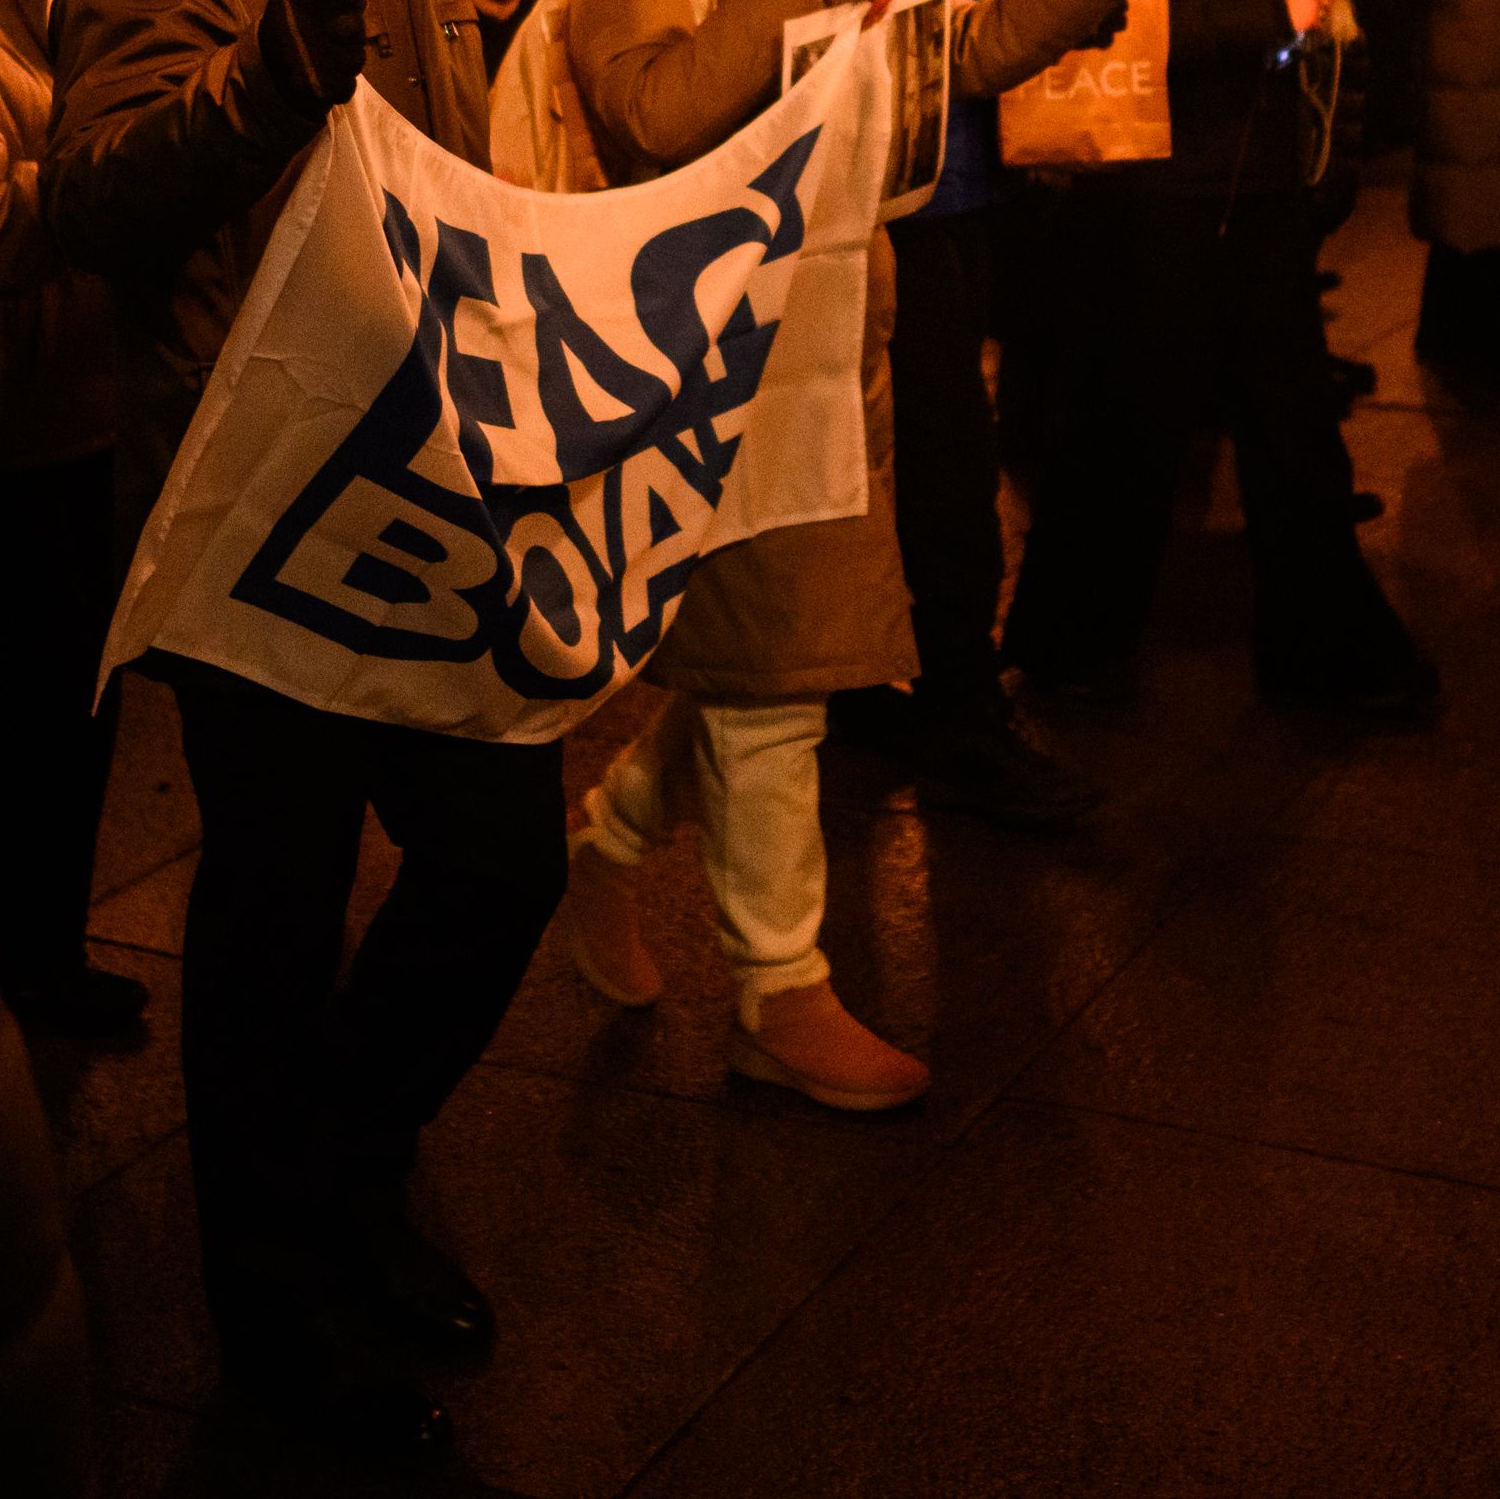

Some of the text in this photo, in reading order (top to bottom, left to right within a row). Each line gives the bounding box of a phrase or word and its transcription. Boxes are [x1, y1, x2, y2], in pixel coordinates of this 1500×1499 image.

[1018, 60, 1154, 101] EACE
[382, 122, 826, 490] EAC
[235, 400, 745, 698] BOA
